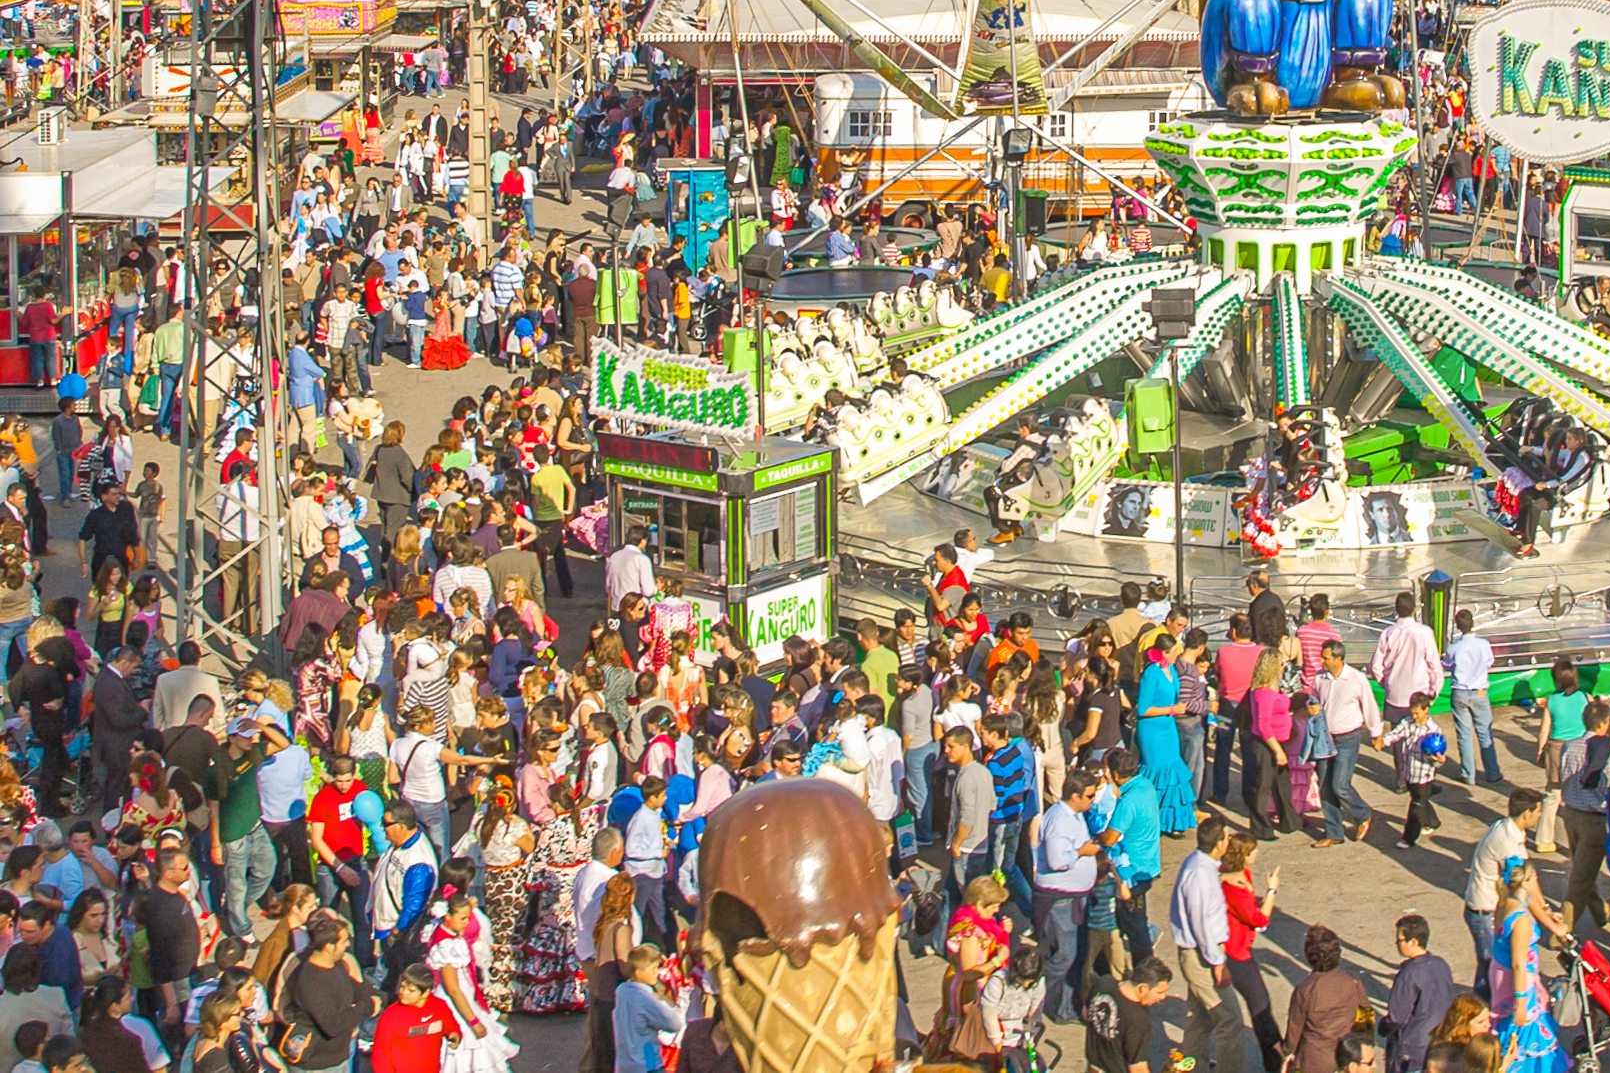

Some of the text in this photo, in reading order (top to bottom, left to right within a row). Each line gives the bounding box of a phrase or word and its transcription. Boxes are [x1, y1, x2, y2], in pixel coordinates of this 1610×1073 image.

[643, 358, 710, 390] SUPER
[598, 350, 748, 429] KANGURO
[618, 462, 704, 487] TAQUILLA
[767, 459, 820, 483] TAQUILLA
[628, 501, 659, 509] ENTRADA
[1044, 490, 1051, 500] 3
[767, 595, 800, 617] SUPER
[747, 597, 816, 650] KANGURO
